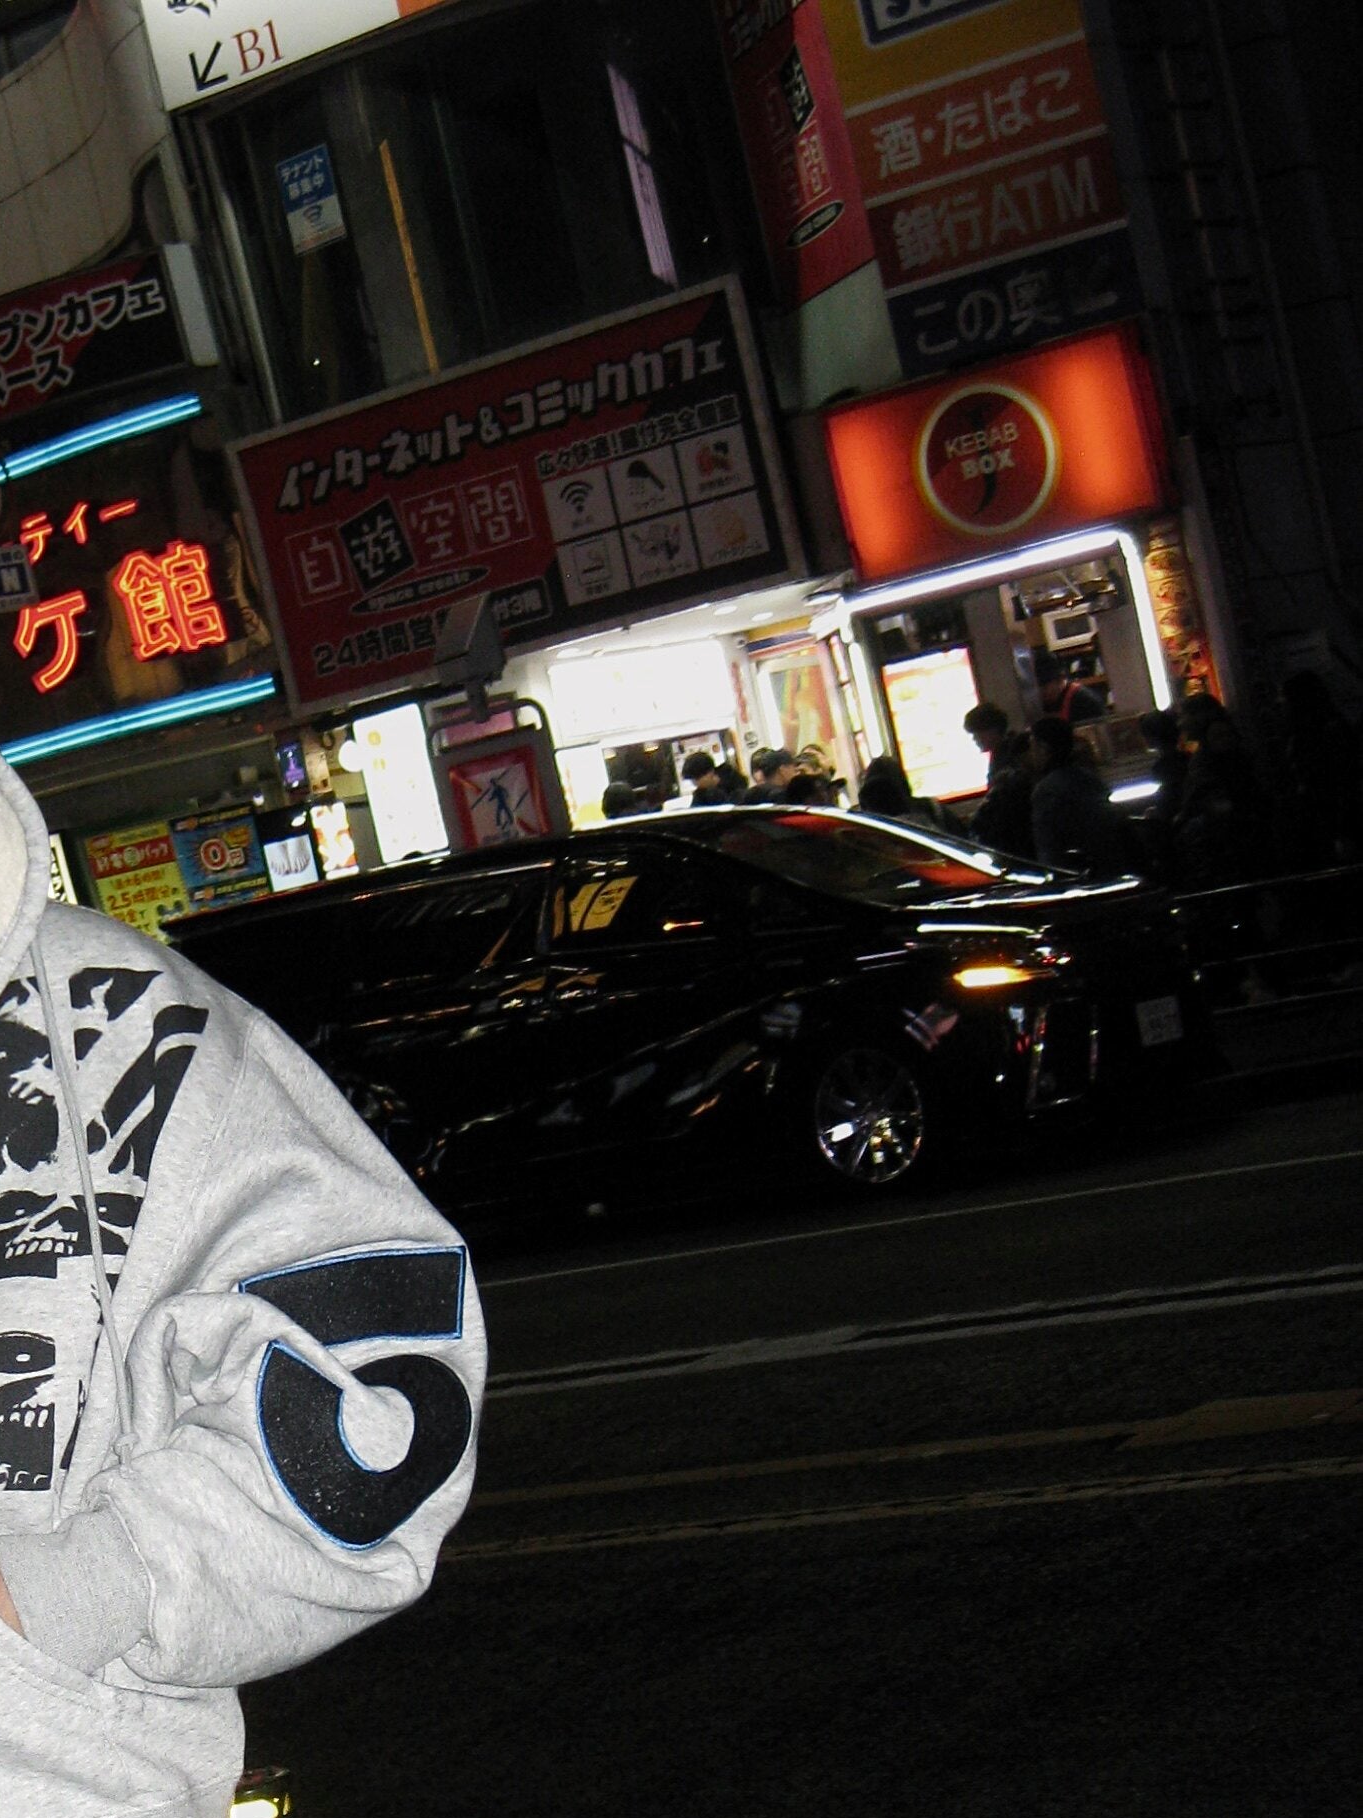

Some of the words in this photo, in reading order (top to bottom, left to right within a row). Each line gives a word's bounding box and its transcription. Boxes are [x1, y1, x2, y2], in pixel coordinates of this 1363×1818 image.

[231, 20, 285, 76] B1
[870, 68, 1082, 178] 酒・たばこ
[892, 156, 1100, 271] 銀行ATM
[275, 337, 727, 513] インターネット&コミックカフェ
[944, 422, 1019, 460] KEBAB
[960, 448, 1015, 480] BOX
[298, 478, 526, 595] 自遊空間
[312, 608, 448, 678] 24時間営
